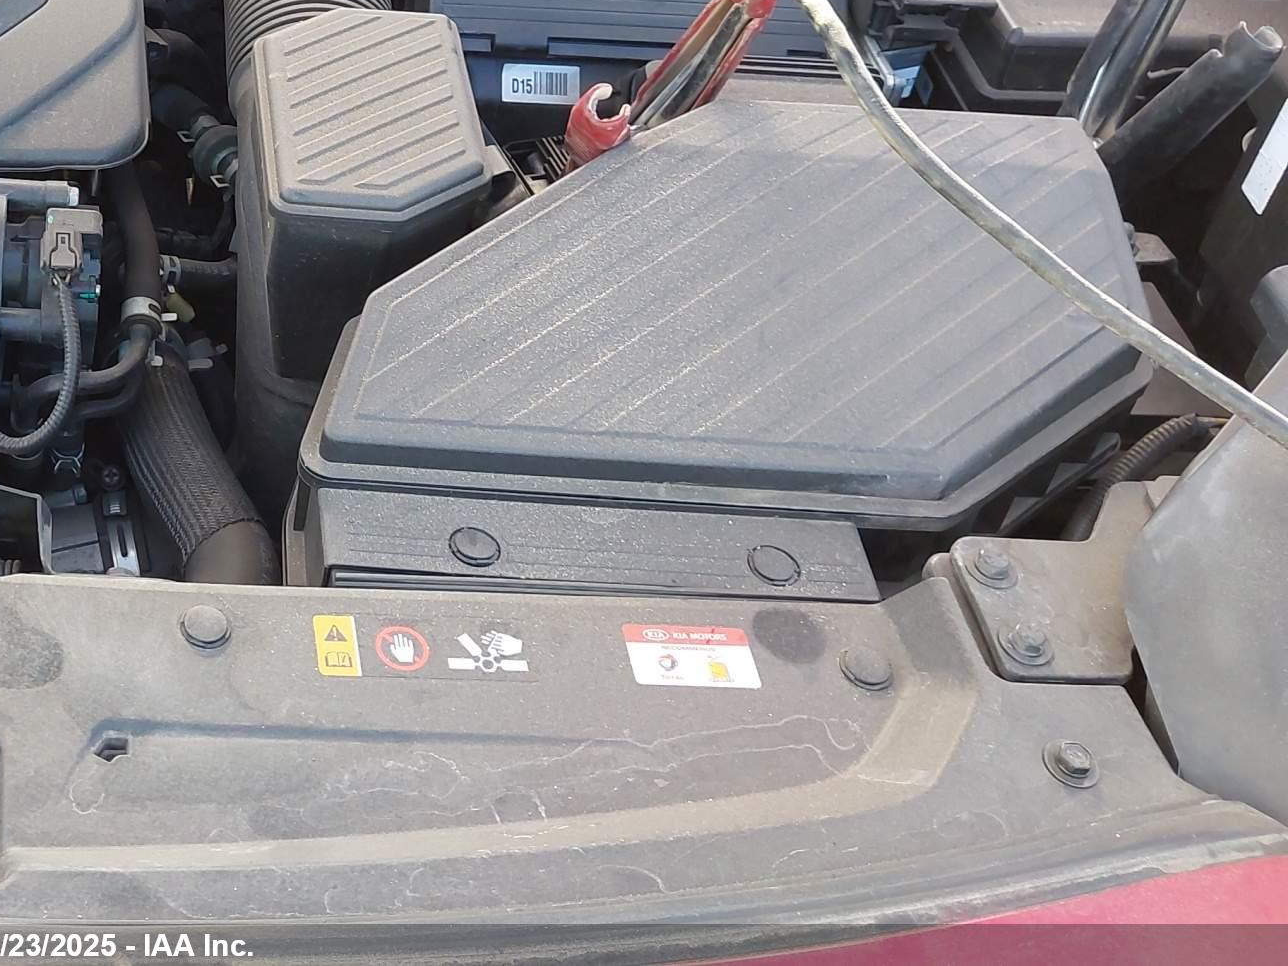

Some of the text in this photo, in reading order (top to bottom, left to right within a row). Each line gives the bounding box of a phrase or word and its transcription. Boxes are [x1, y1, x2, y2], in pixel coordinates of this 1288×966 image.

[511, 78, 533, 94] D15
[672, 632, 689, 640] KIA
[689, 633, 729, 641] MOTORS
